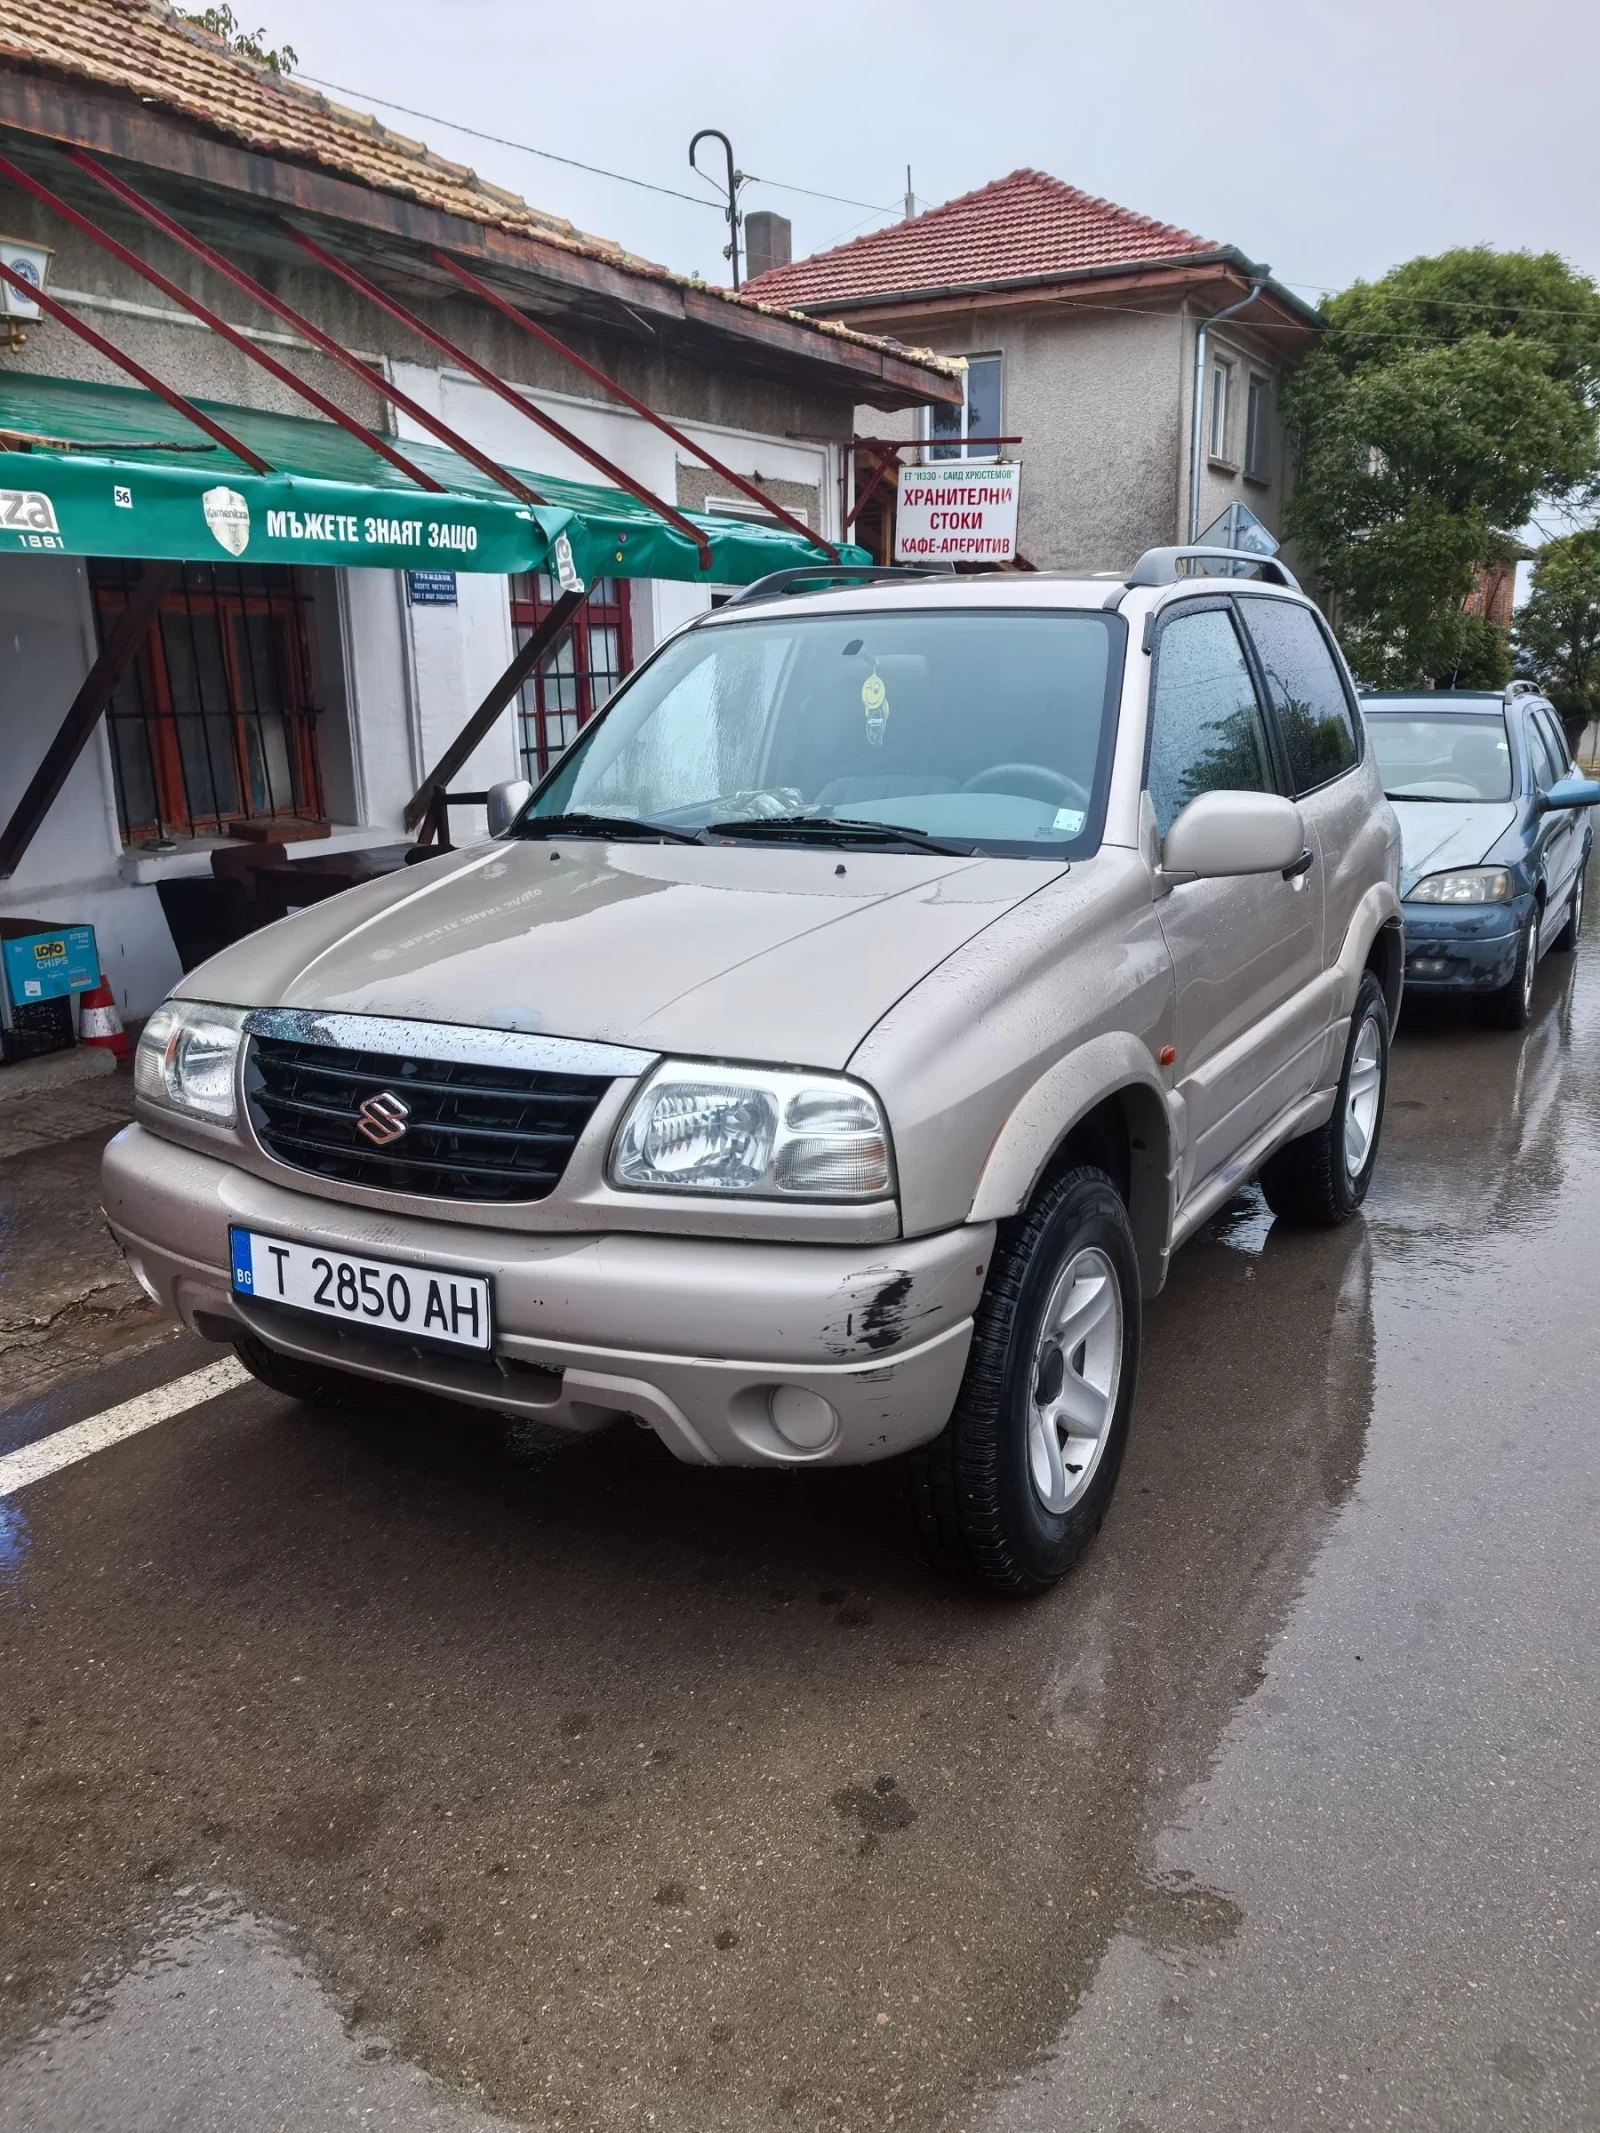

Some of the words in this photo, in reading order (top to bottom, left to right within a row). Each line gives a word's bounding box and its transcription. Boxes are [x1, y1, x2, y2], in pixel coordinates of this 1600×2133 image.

[904, 472, 912, 481] ЕТ
[943, 471, 963, 481] САИД
[115, 490, 130, 503] 56
[904, 488, 1012, 506] ХРАНИТЕЛНИ
[205, 507, 248, 520] Kamenitza
[930, 512, 983, 530] СТОКИ
[267, 510, 359, 542] МЪЖЕТЕ
[365, 517, 423, 547] ЗНАЯТ
[428, 523, 478, 552] ЗАЩО
[19, 534, 64, 549] 1881
[901, 537, 1010, 554] КАФЕ-АПЕРИТИВ
[36, 956, 68, 969] CHIPS
[236, 1268, 252, 1285] BG
[268, 1246, 290, 1296] T
[311, 1257, 412, 1323] 2850
[423, 1279, 480, 1339] AH
